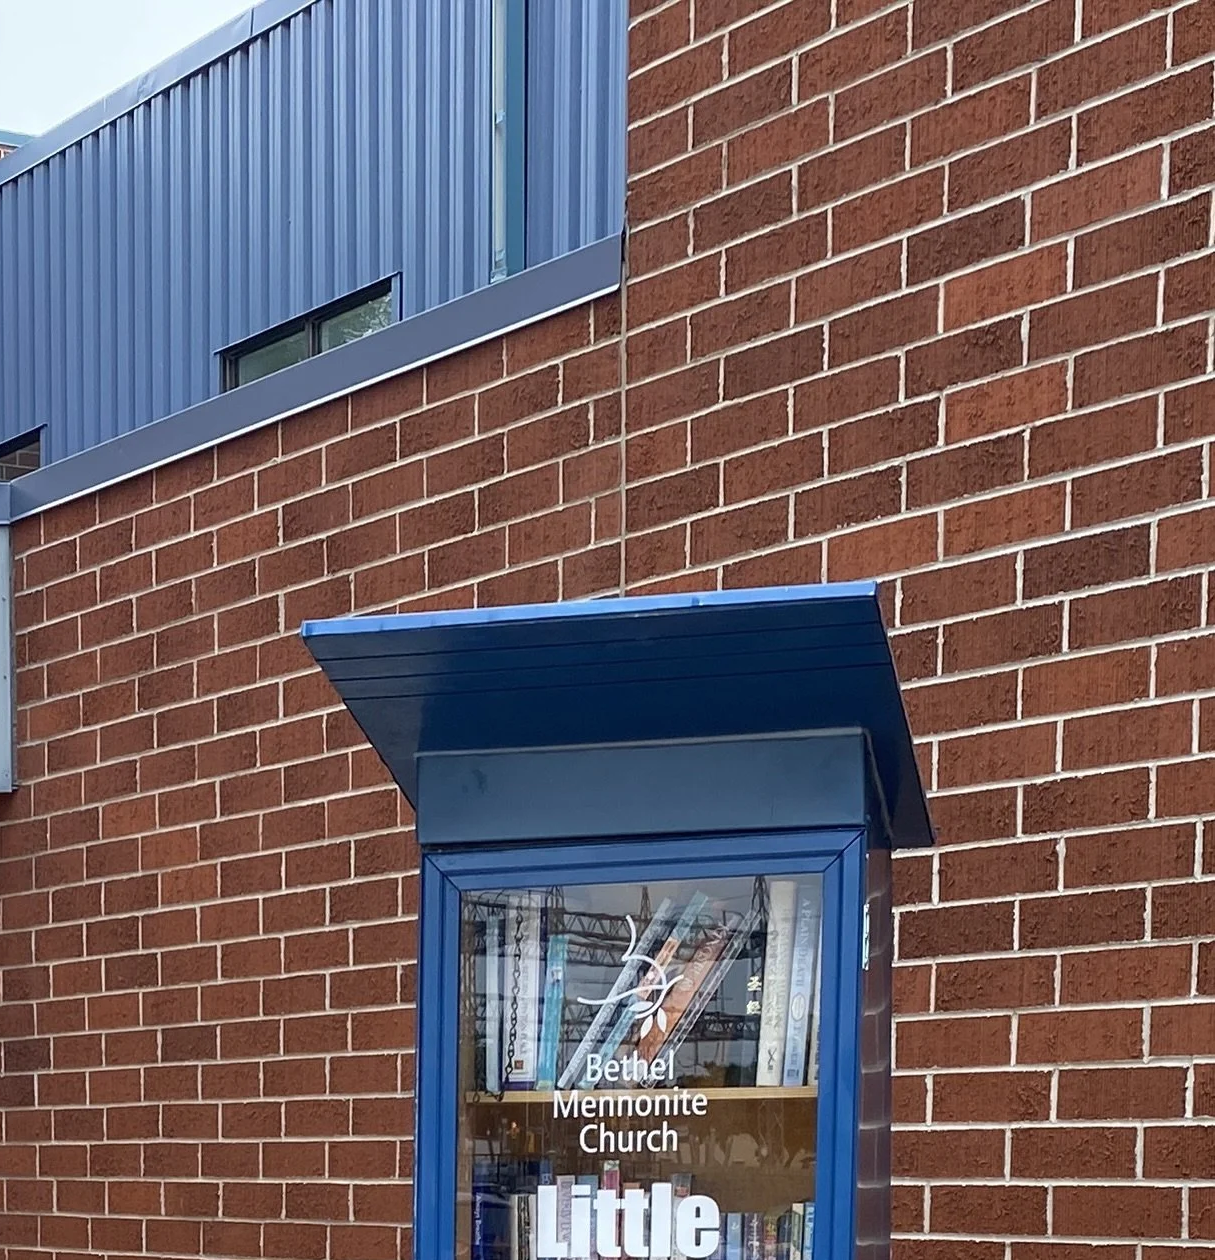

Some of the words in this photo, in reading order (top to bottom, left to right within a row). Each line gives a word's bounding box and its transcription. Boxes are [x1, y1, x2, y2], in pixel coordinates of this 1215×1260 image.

[586, 1049, 675, 1083] Bethel
[553, 1088, 708, 1118] Mennonite
[579, 1121, 678, 1154] Church
[537, 1182, 720, 1259] Little
